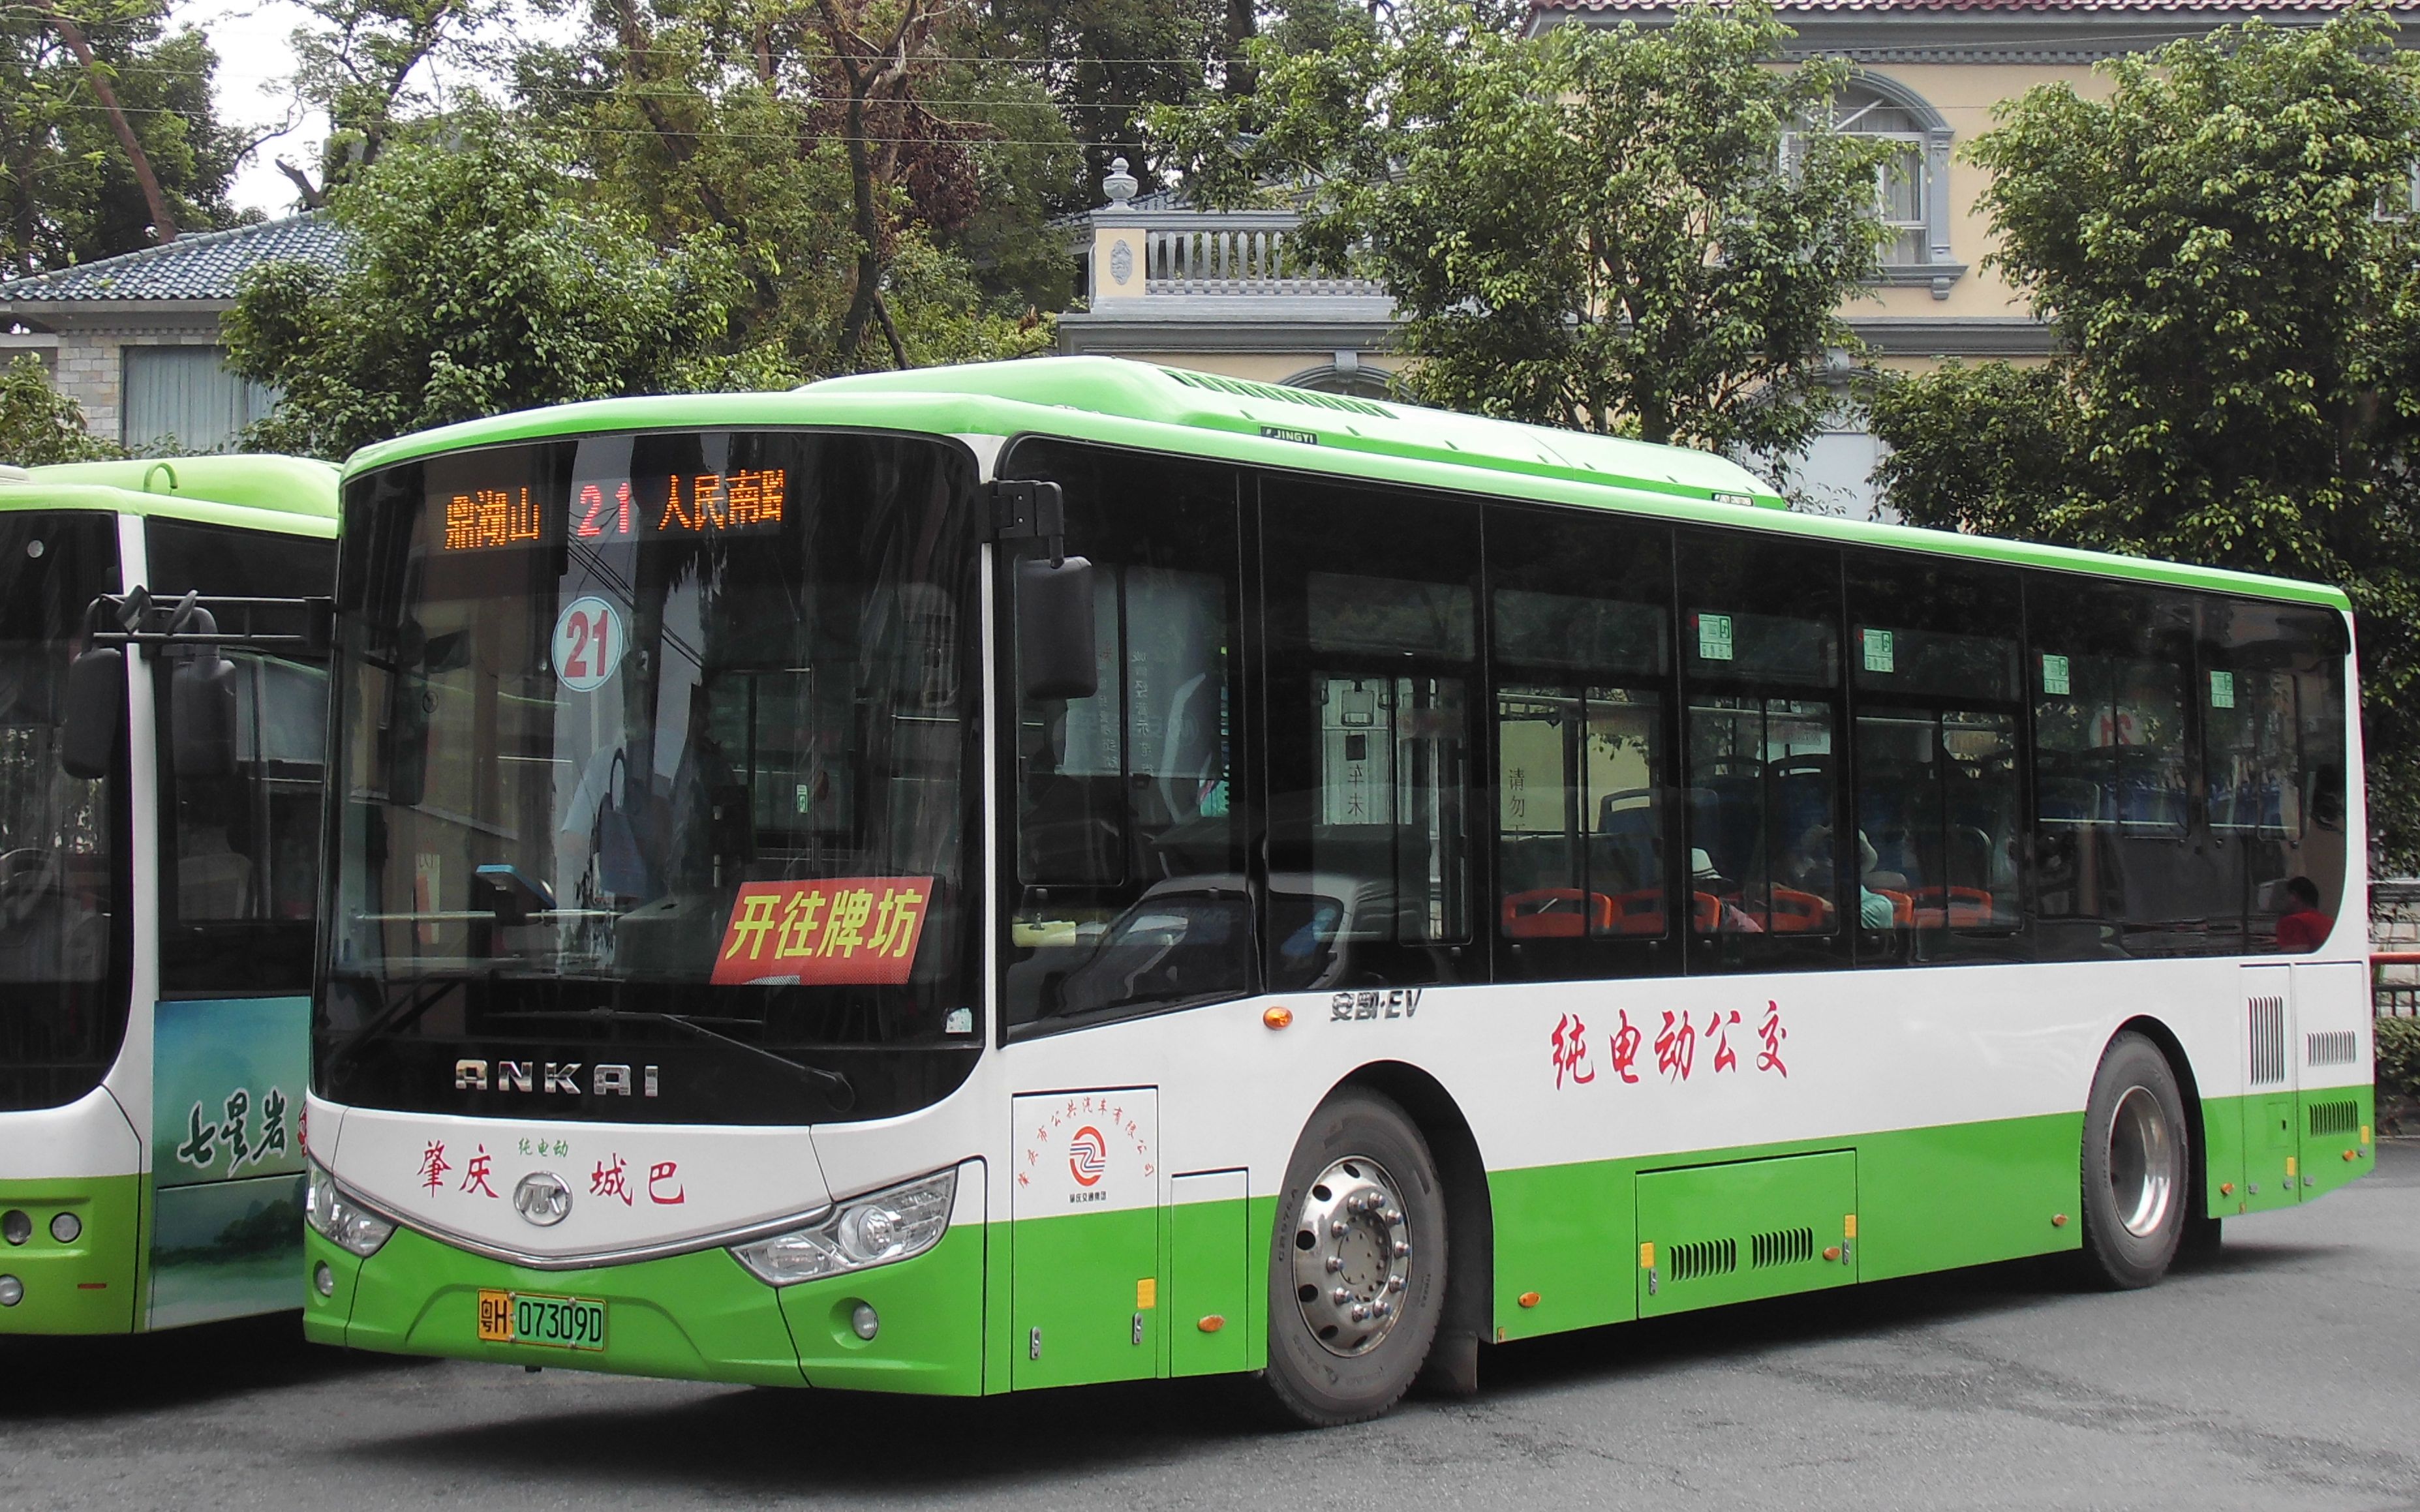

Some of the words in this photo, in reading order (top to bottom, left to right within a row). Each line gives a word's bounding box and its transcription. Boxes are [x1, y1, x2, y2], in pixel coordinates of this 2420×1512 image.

[1274, 430, 1313, 443] JINGYI
[444, 486, 540, 550] 鼎湖山
[577, 481, 631, 537] 21
[658, 468, 785, 532] 人民南路
[564, 609, 609, 678] 21
[724, 887, 925, 960] 开往牌坊
[455, 1059, 659, 1097] ANKAI
[1550, 999, 1789, 1091] 纯电动公交
[177, 1085, 288, 1178] 七星岩
[517, 1138, 570, 1158] 纯电动
[416, 1139, 500, 1200] 肇庆
[589, 1152, 686, 1207] 城巴
